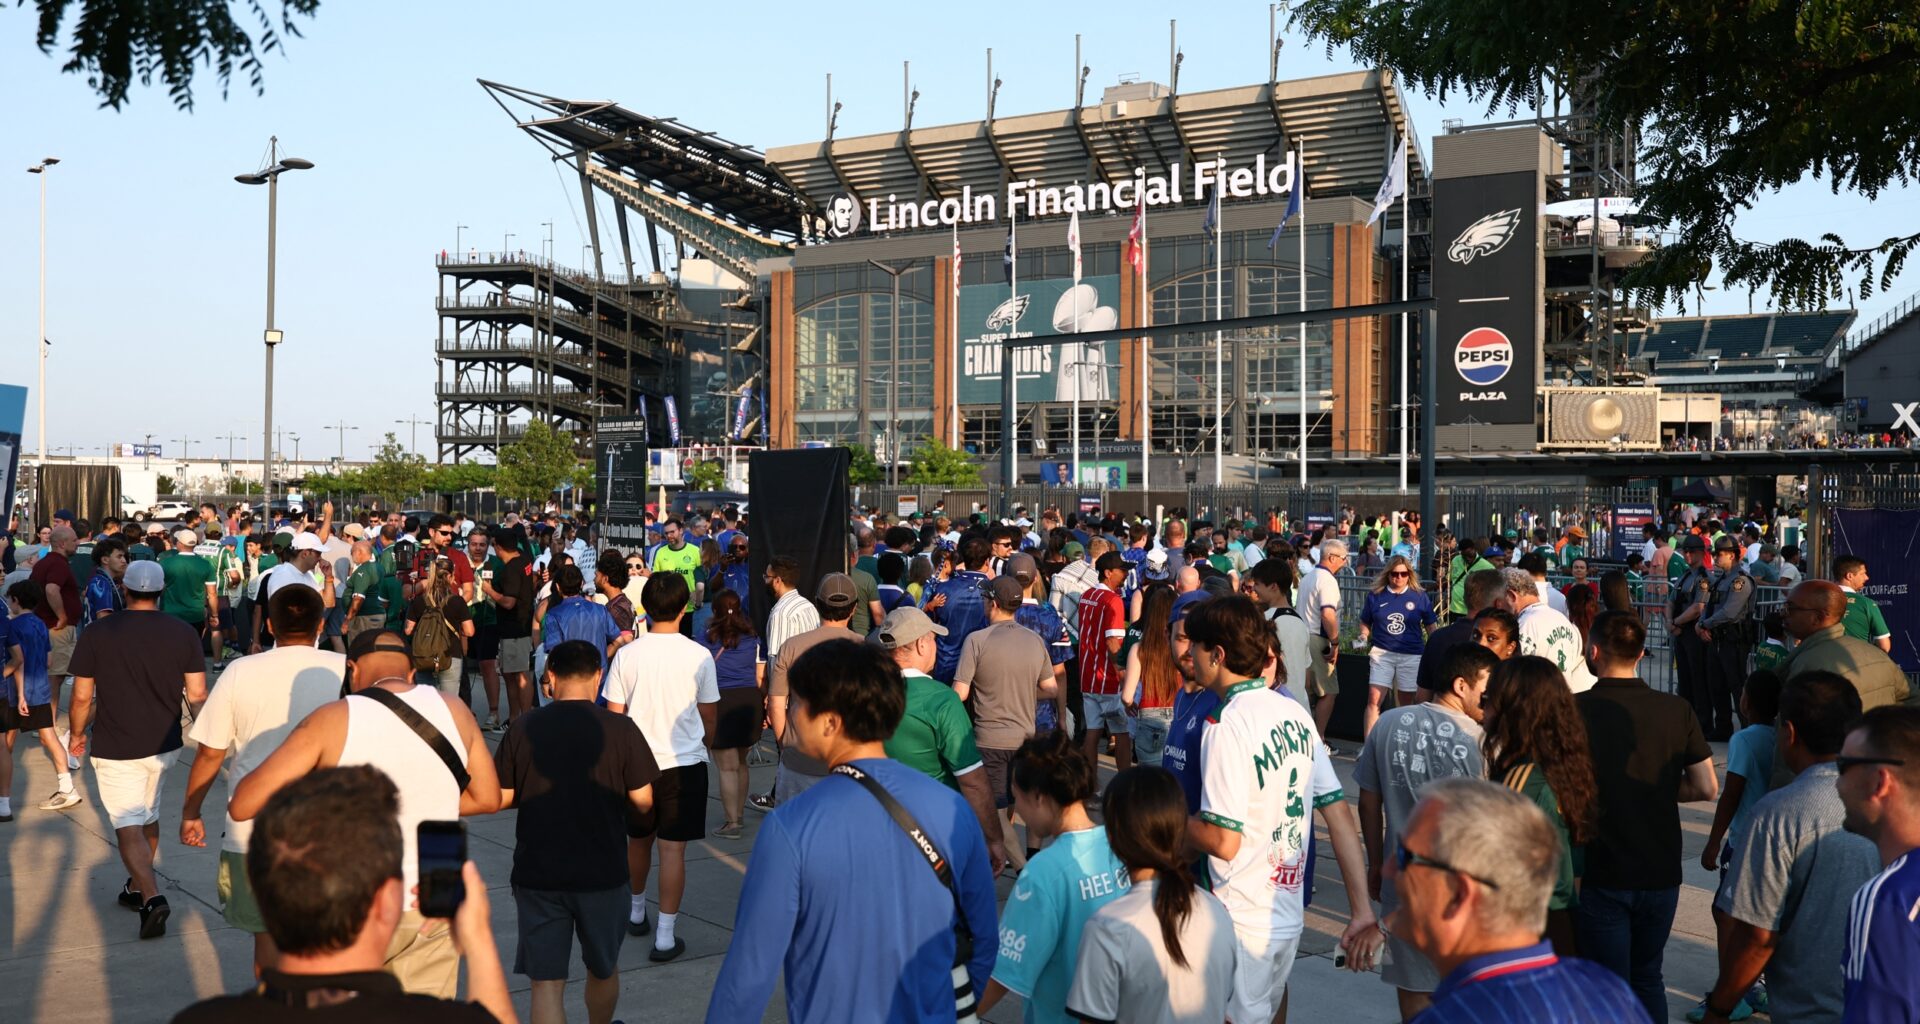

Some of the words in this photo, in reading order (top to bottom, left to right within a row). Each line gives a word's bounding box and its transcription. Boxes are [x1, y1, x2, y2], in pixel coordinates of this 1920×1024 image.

[870, 185, 995, 231] Lincoln
[1008, 162, 1182, 218] Financial
[1195, 151, 1296, 200] Field
[981, 333, 1007, 343] SUPER
[965, 344, 1052, 376] CHAMIONS
[1458, 350, 1509, 363] PEPSI
[1460, 391, 1507, 401] PLAZA
[1090, 446, 1113, 454] GEST
[1897, 584, 1908, 594] SIZE
[910, 828, 939, 863] SONY
[1079, 872, 1113, 901] HEE
